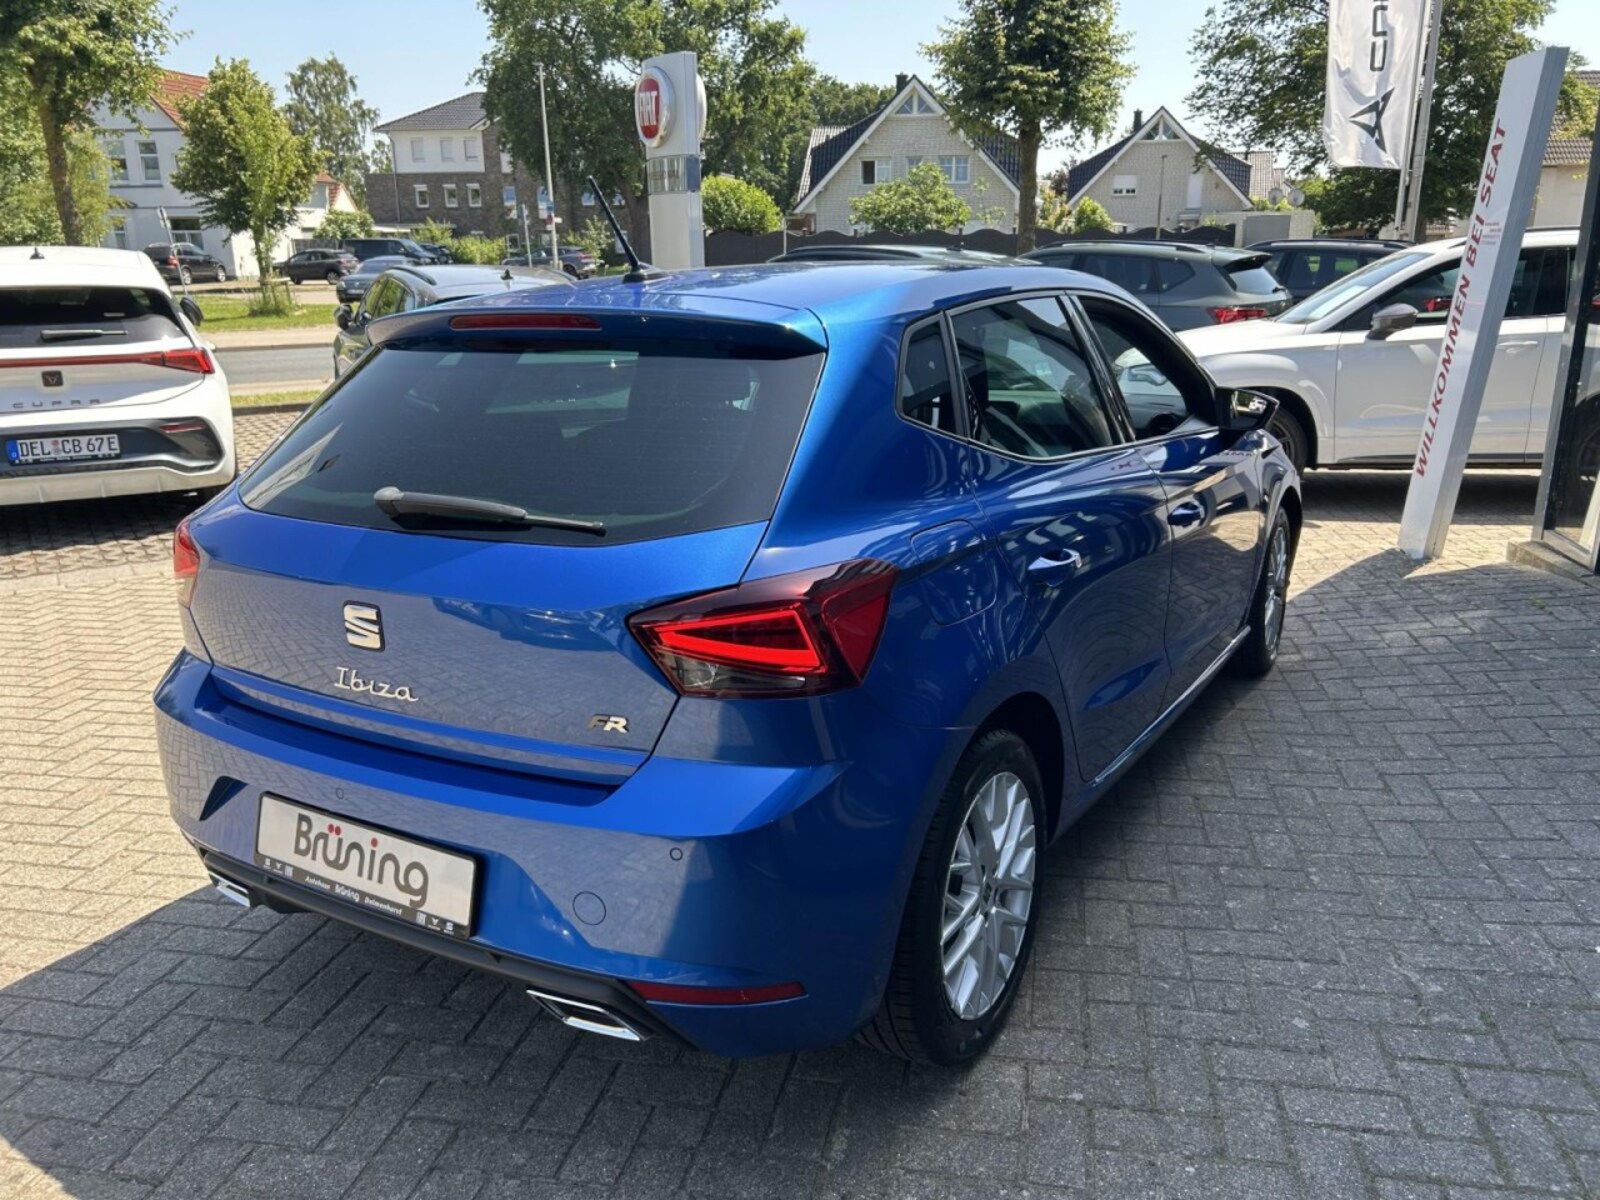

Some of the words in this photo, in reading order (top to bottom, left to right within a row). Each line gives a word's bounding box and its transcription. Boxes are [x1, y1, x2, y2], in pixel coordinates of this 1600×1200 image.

[639, 91, 658, 126] FIAT
[1416, 275, 1470, 477] WILLKOMMEN
[1466, 214, 1485, 268] BEI
[1480, 118, 1506, 208] SEAT
[12, 399, 100, 408] CUPRA
[19, 441, 51, 457] DEL
[61, 439, 82, 454] CB
[334, 666, 419, 701] Ibiza
[587, 715, 628, 733] FR
[294, 813, 429, 908] Brüning
